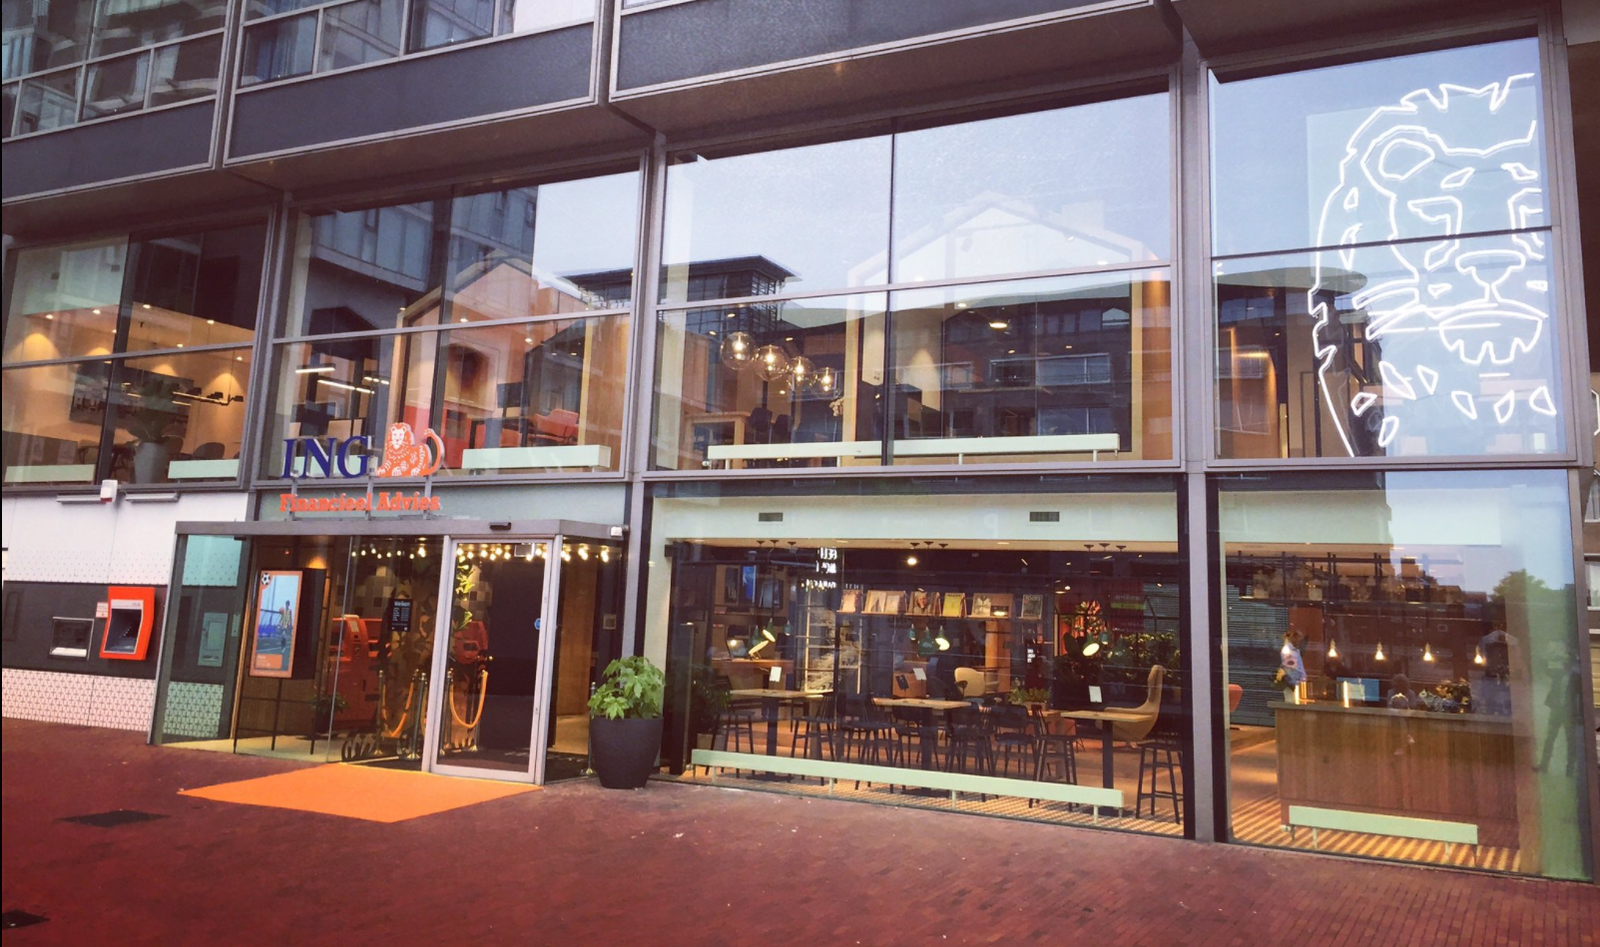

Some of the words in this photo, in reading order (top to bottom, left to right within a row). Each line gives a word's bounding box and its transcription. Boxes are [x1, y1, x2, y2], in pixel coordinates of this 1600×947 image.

[282, 436, 369, 479] ING
[279, 492, 372, 512] Financieel
[376, 491, 440, 511] Advies
